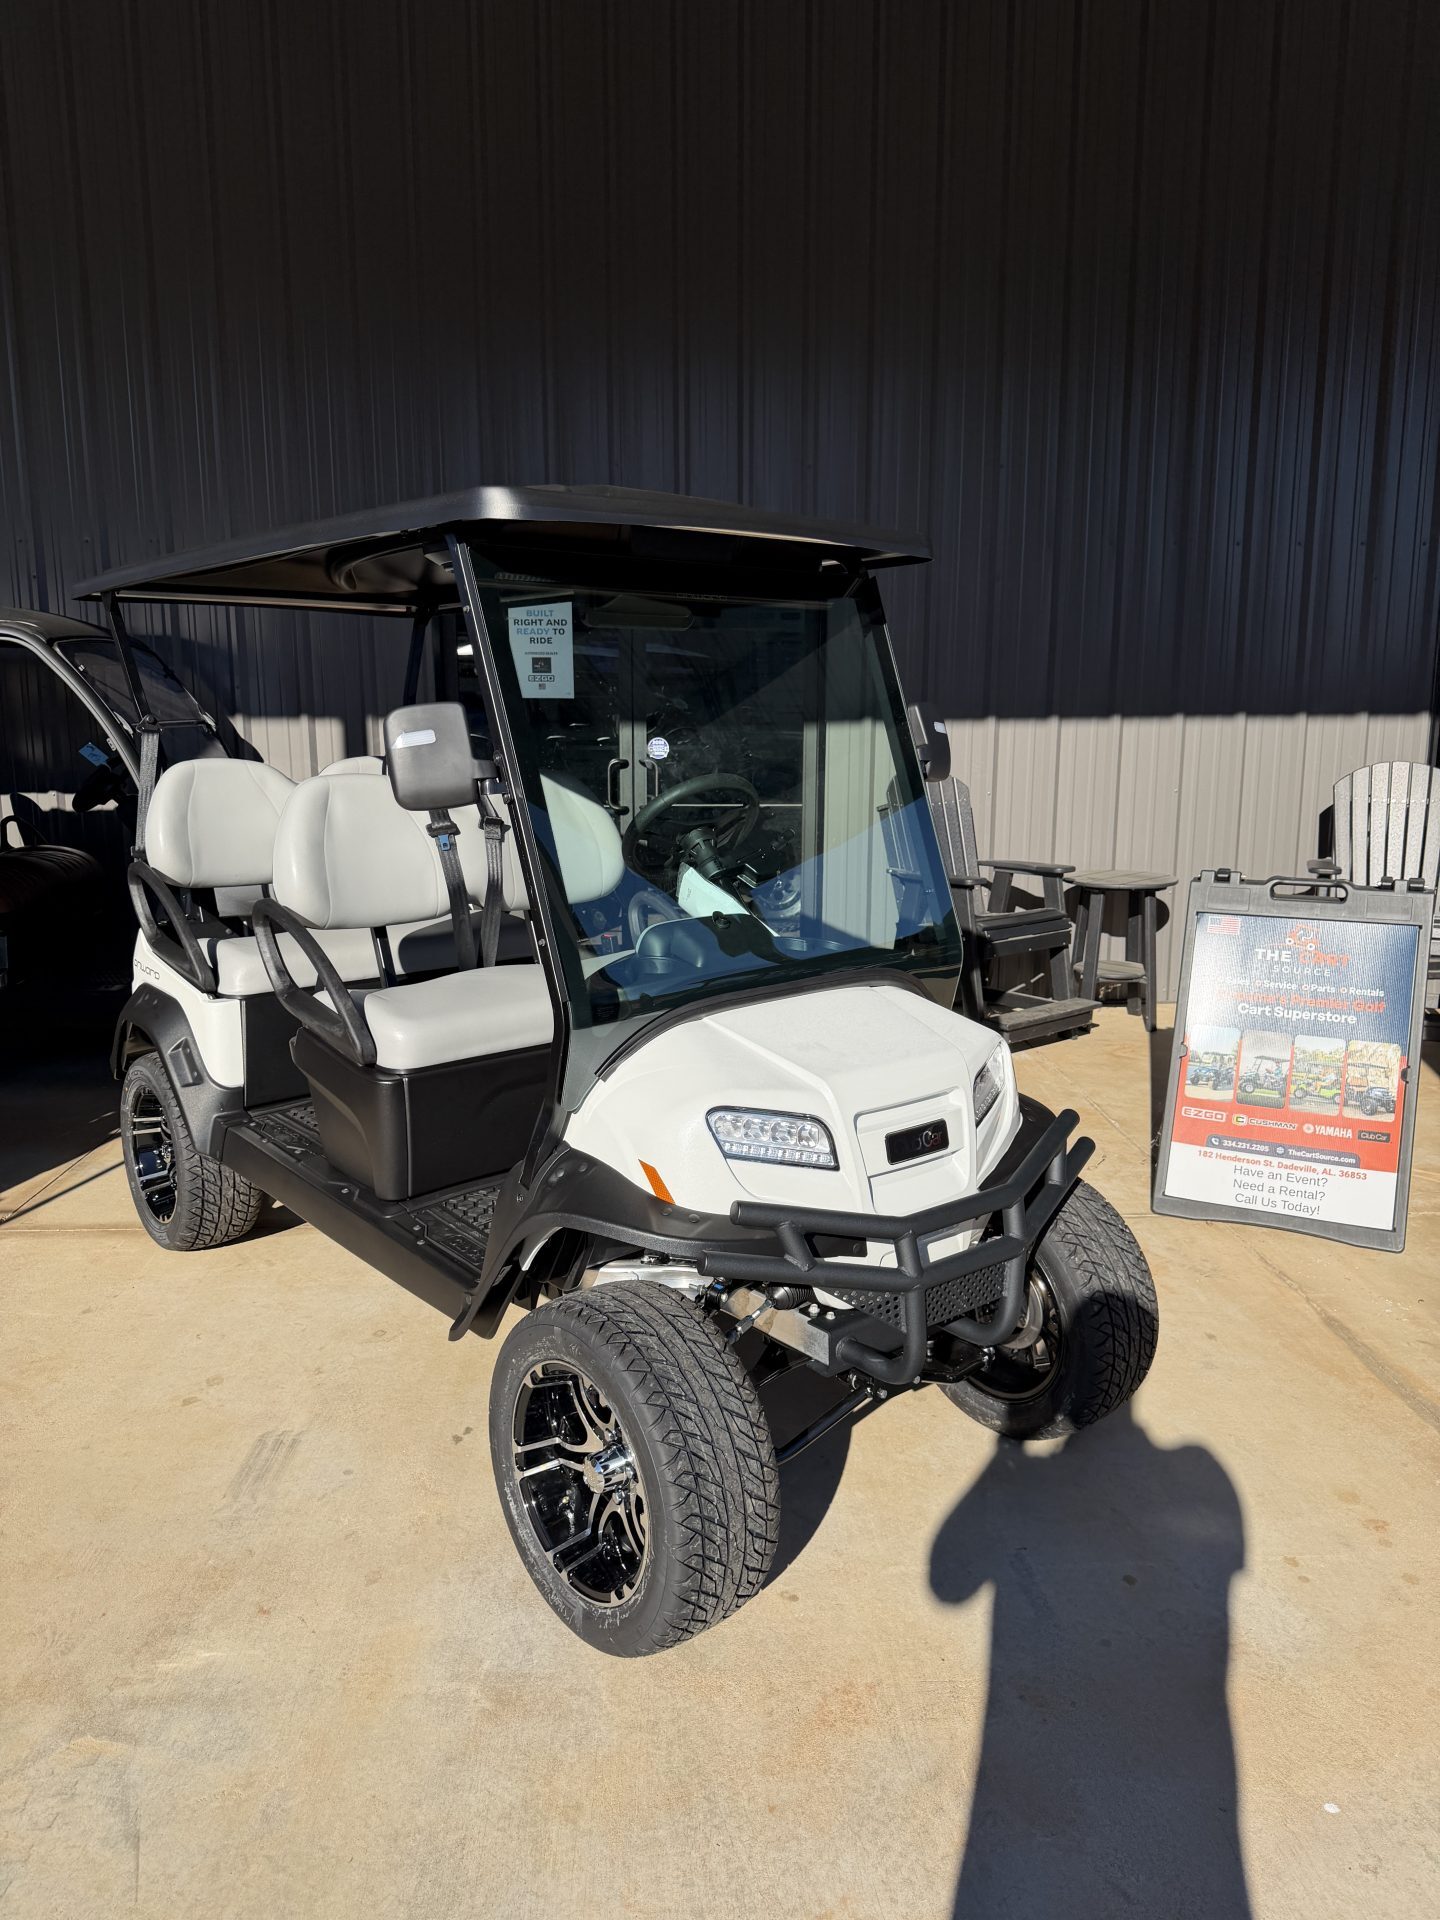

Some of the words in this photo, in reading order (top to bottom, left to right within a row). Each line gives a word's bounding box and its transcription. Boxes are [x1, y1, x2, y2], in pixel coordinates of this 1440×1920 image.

[1255, 948, 1291, 962] THE
[1273, 966, 1331, 977] SOURCE
[1264, 980, 1298, 990] Service
[1311, 984, 1336, 993] Parts
[1349, 987, 1385, 997] Rentals
[1238, 1003, 1272, 1016] Cart
[1274, 1006, 1357, 1024] Superstore
[1183, 1108, 1225, 1121] EZGO
[1249, 1118, 1296, 1129] CUSHMAN
[1315, 1125, 1352, 1138] YAMAHA
[1288, 1149, 1356, 1164] TheCartSource.com
[1198, 1150, 1213, 1158] 182
[1215, 1152, 1261, 1165] Henderson
[1263, 1159, 1275, 1168] St.
[1277, 1161, 1319, 1175] Dadeville,
[1322, 1167, 1336, 1176] AL.
[1338, 1170, 1367, 1180] 36853
[1233, 1165, 1264, 1178] Have
[1267, 1171, 1282, 1181] an
[1286, 1172, 1328, 1187] Event?
[1233, 1178, 1264, 1192] Need
[1268, 1185, 1275, 1194] a
[1279, 1185, 1326, 1200] Rental?
[1234, 1193, 1258, 1205] Call
[1261, 1197, 1277, 1208] Us
[1281, 1200, 1320, 1215] Today!
